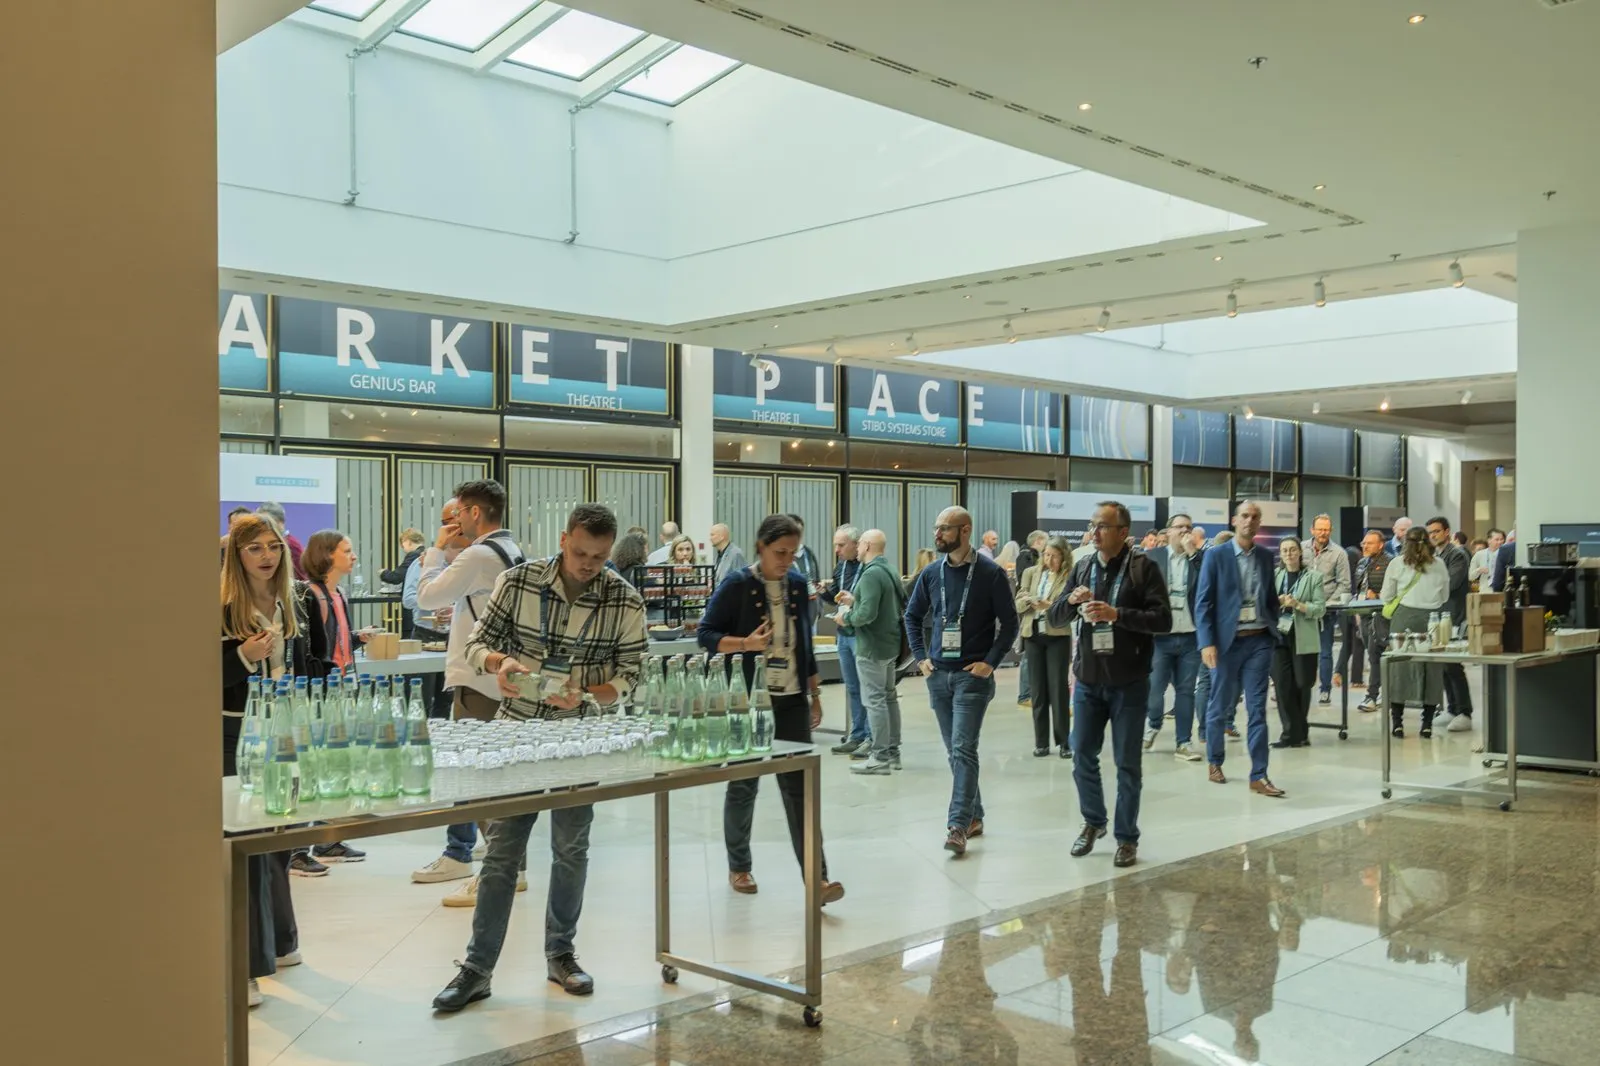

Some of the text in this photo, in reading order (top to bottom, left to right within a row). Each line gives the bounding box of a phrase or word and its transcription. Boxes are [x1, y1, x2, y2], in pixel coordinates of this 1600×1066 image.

[350, 374, 437, 395] GENIUS BAR
[566, 392, 624, 410] THEATRE I
[751, 409, 800, 425] THEATRE II
[861, 419, 947, 439] STIBO SYSTEMS STORE
